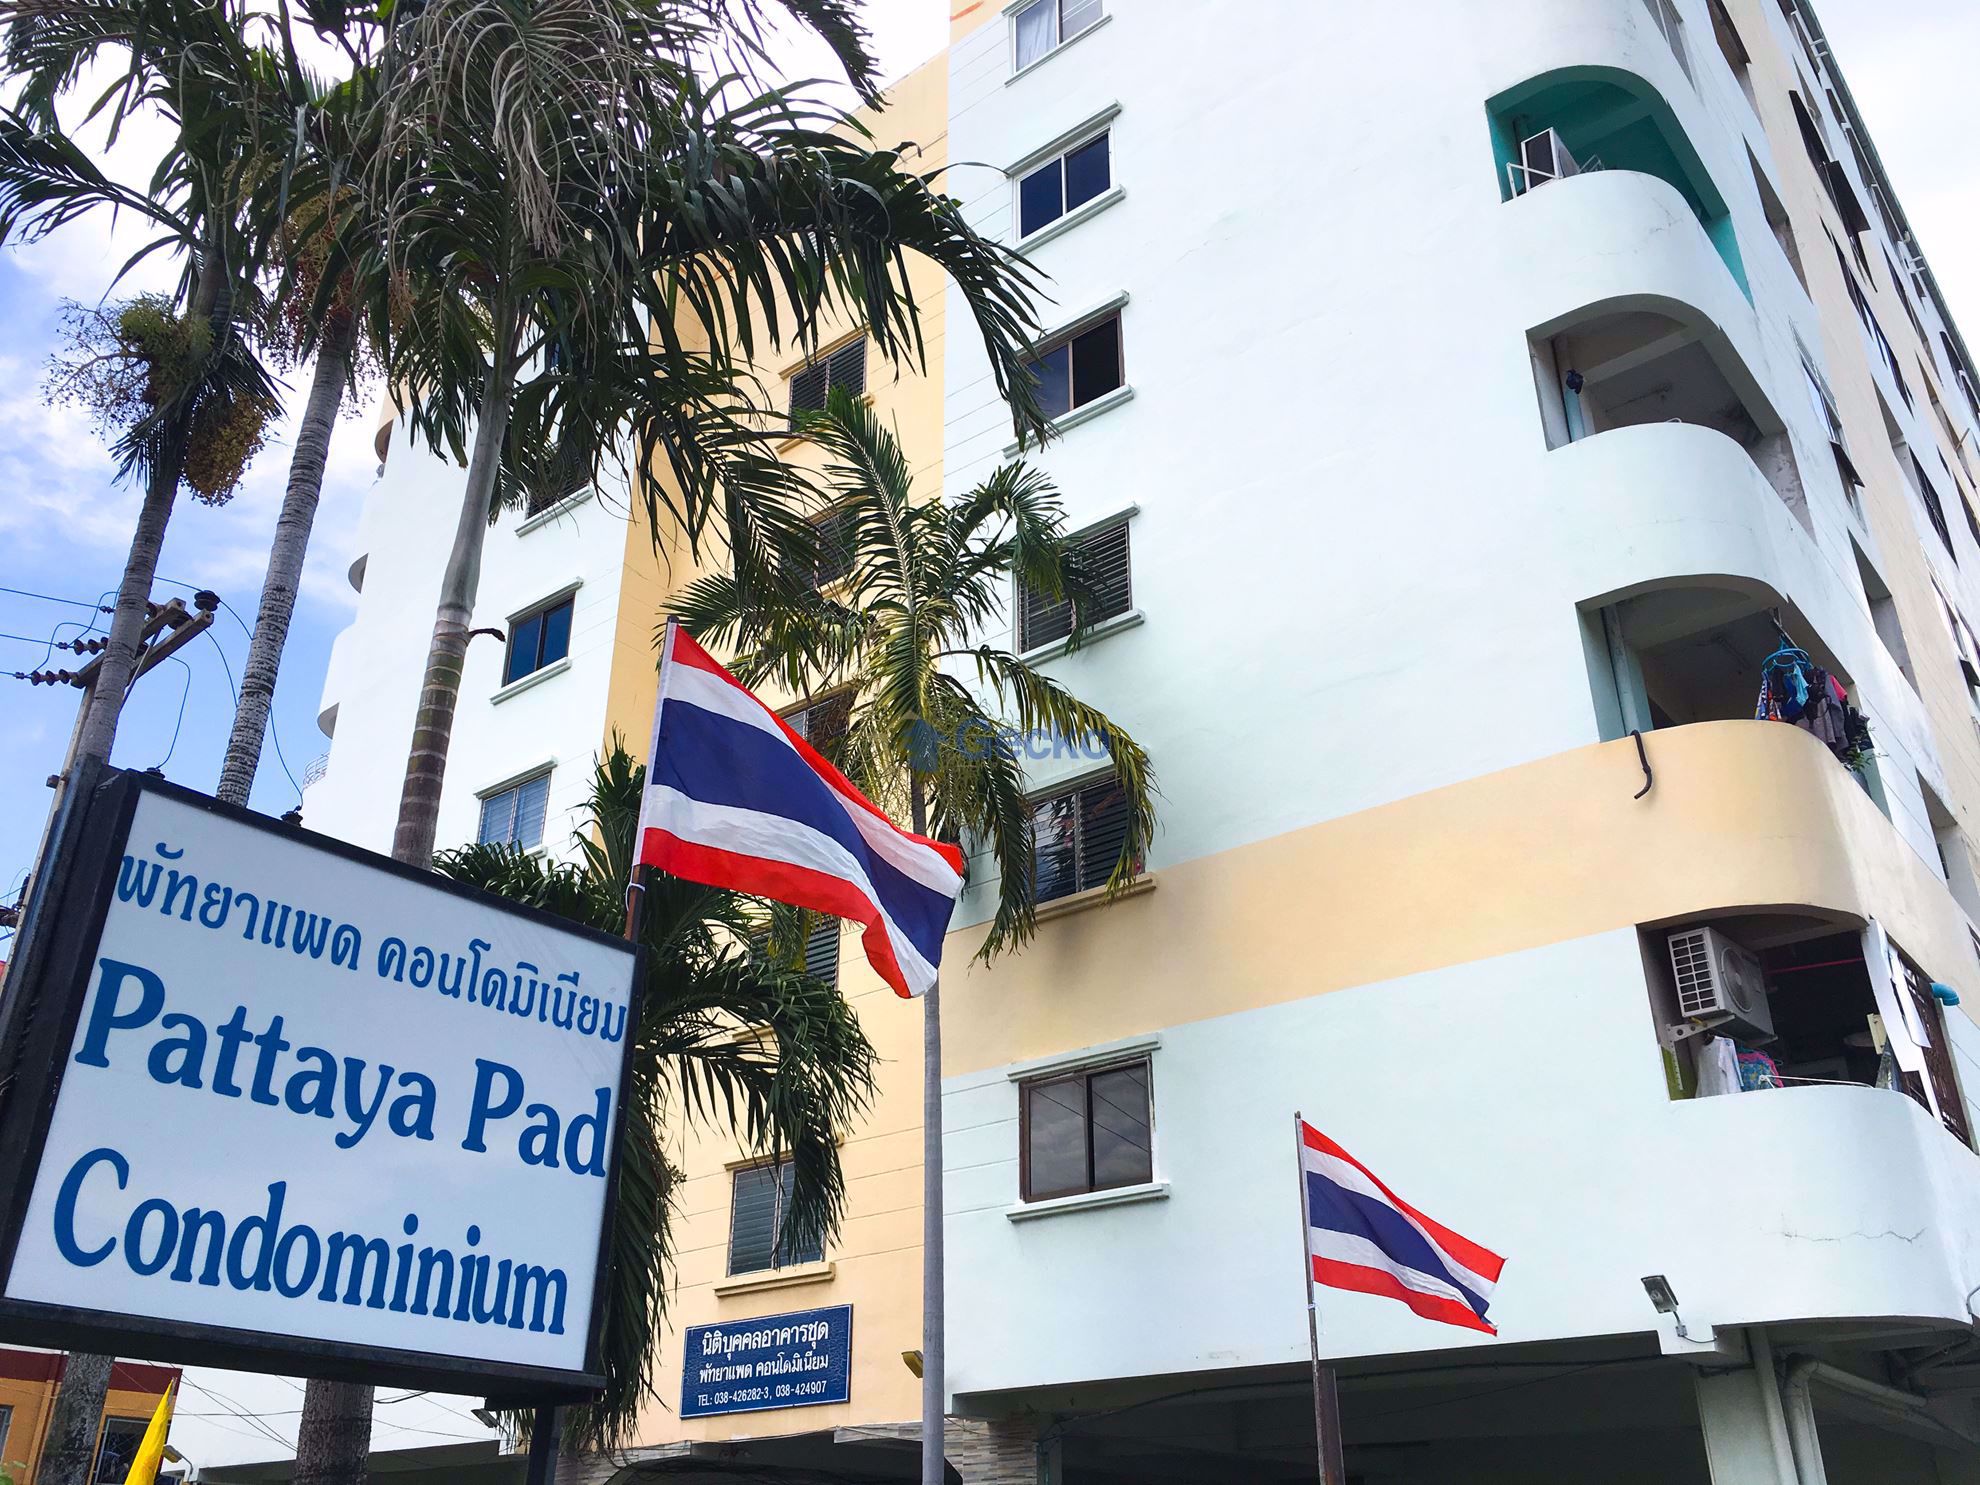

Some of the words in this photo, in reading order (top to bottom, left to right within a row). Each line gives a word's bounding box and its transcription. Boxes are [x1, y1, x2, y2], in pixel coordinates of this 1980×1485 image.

[117, 841, 362, 972] พัทยาแพด
[377, 937, 629, 1043] คอนโดมิเนียม
[74, 957, 437, 1150] Pattaya
[461, 1057, 612, 1179] Pad
[53, 1147, 568, 1336] Condominium
[699, 1362, 753, 1383] พัทยาแพด
[756, 1351, 829, 1377] คอนโดมิเนียม
[702, 1321, 829, 1360] นิติบุคคลอาคารชุด
[775, 1380, 827, 1397] 038-424907
